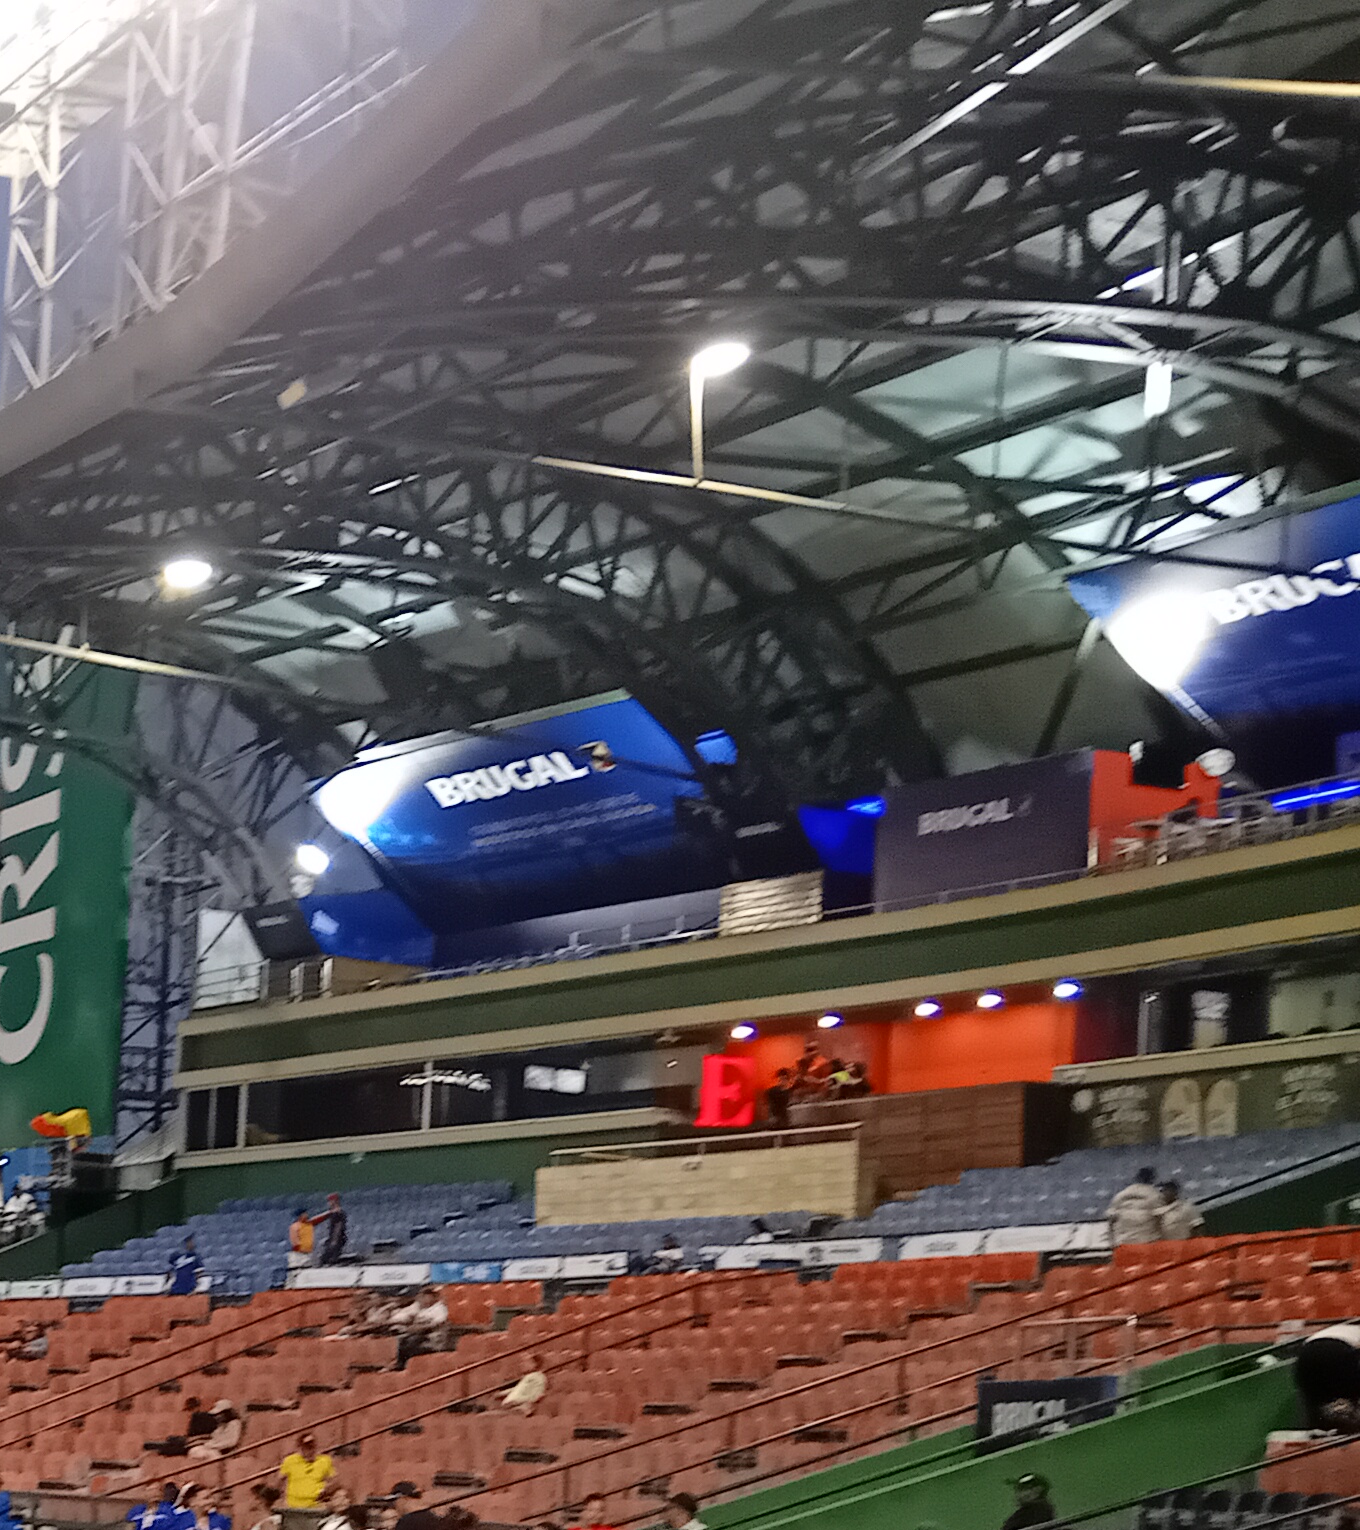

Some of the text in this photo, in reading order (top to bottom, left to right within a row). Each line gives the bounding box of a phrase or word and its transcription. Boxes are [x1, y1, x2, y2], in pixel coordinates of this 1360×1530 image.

[1208, 553, 1360, 625] BRUG
[424, 751, 590, 808] BRUGAL
[917, 798, 1014, 836] BRUGAL
